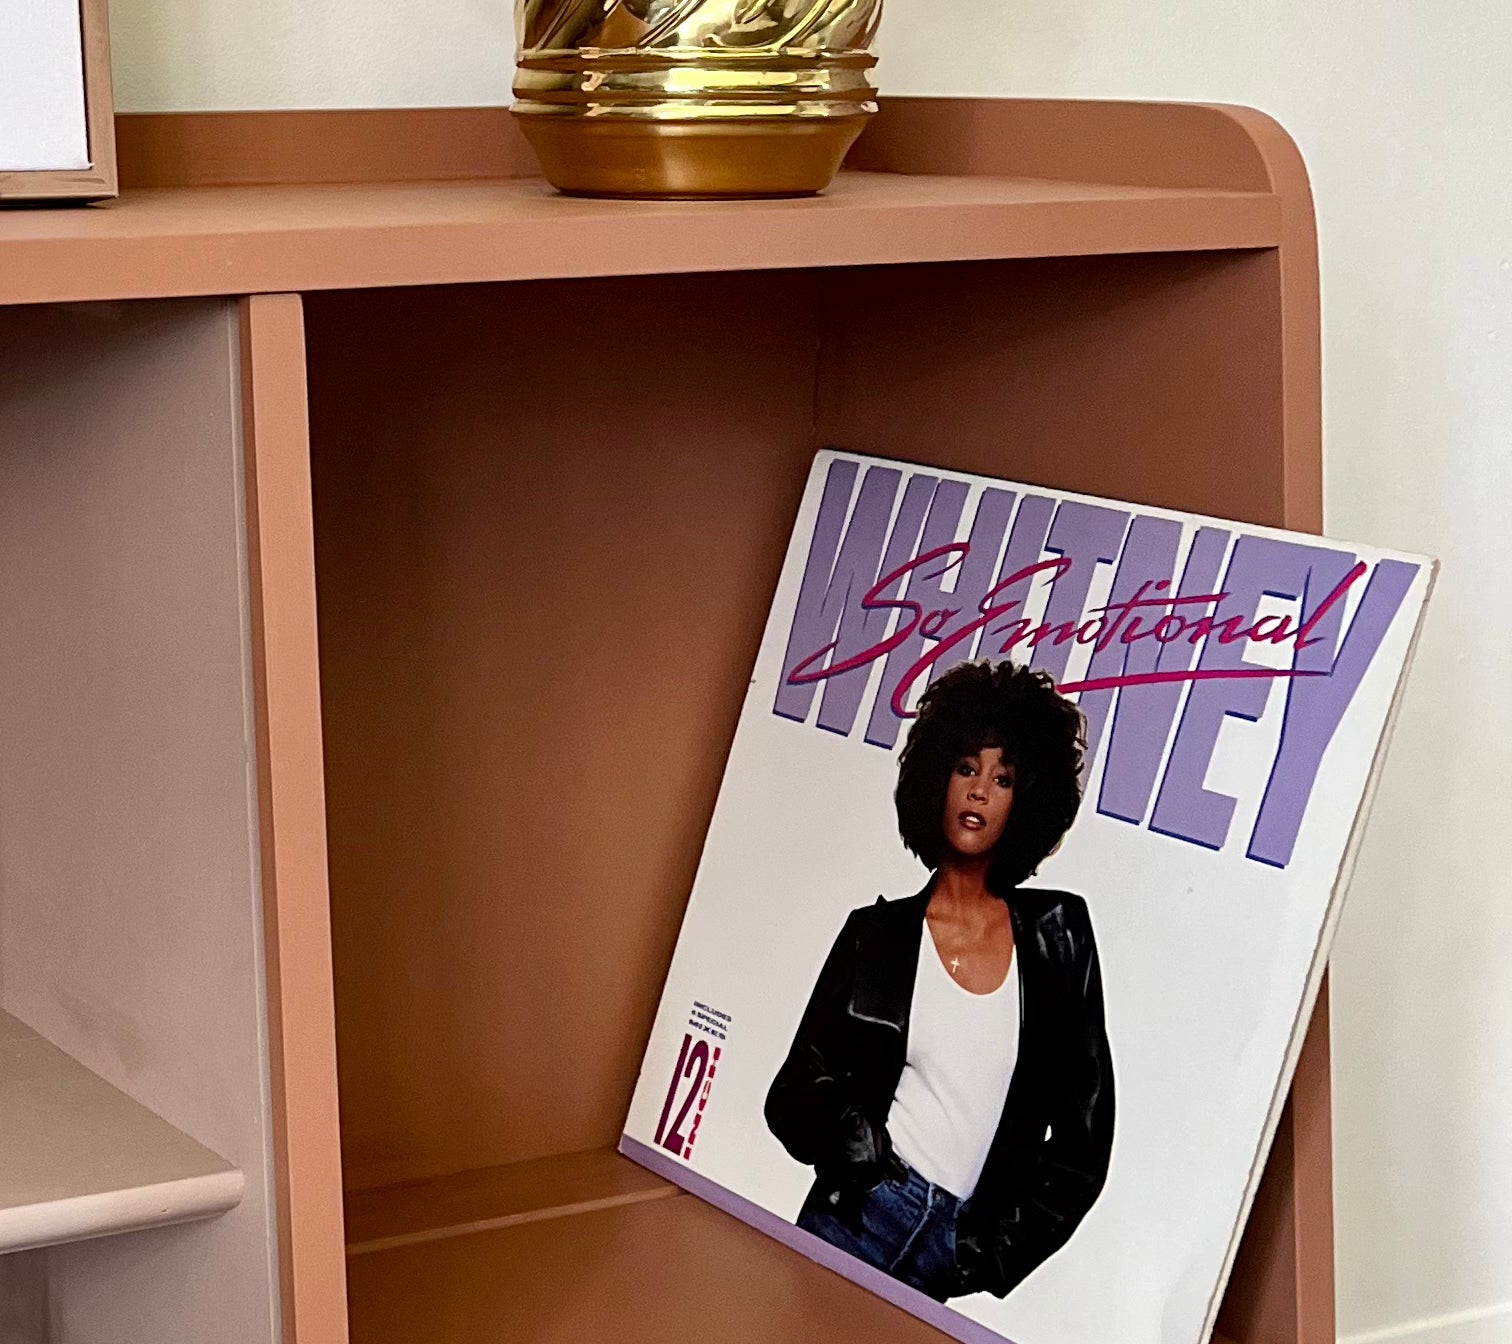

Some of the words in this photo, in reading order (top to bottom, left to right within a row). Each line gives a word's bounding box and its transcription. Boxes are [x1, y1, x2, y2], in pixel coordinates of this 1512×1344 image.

[773, 459, 1420, 869] WHITNEY
[788, 542, 970, 685] So
[891, 558, 1366, 719] Emotional
[688, 1019, 727, 1040] MIXES
[654, 1033, 710, 1156] 12
[683, 1047, 722, 1160] INCH
